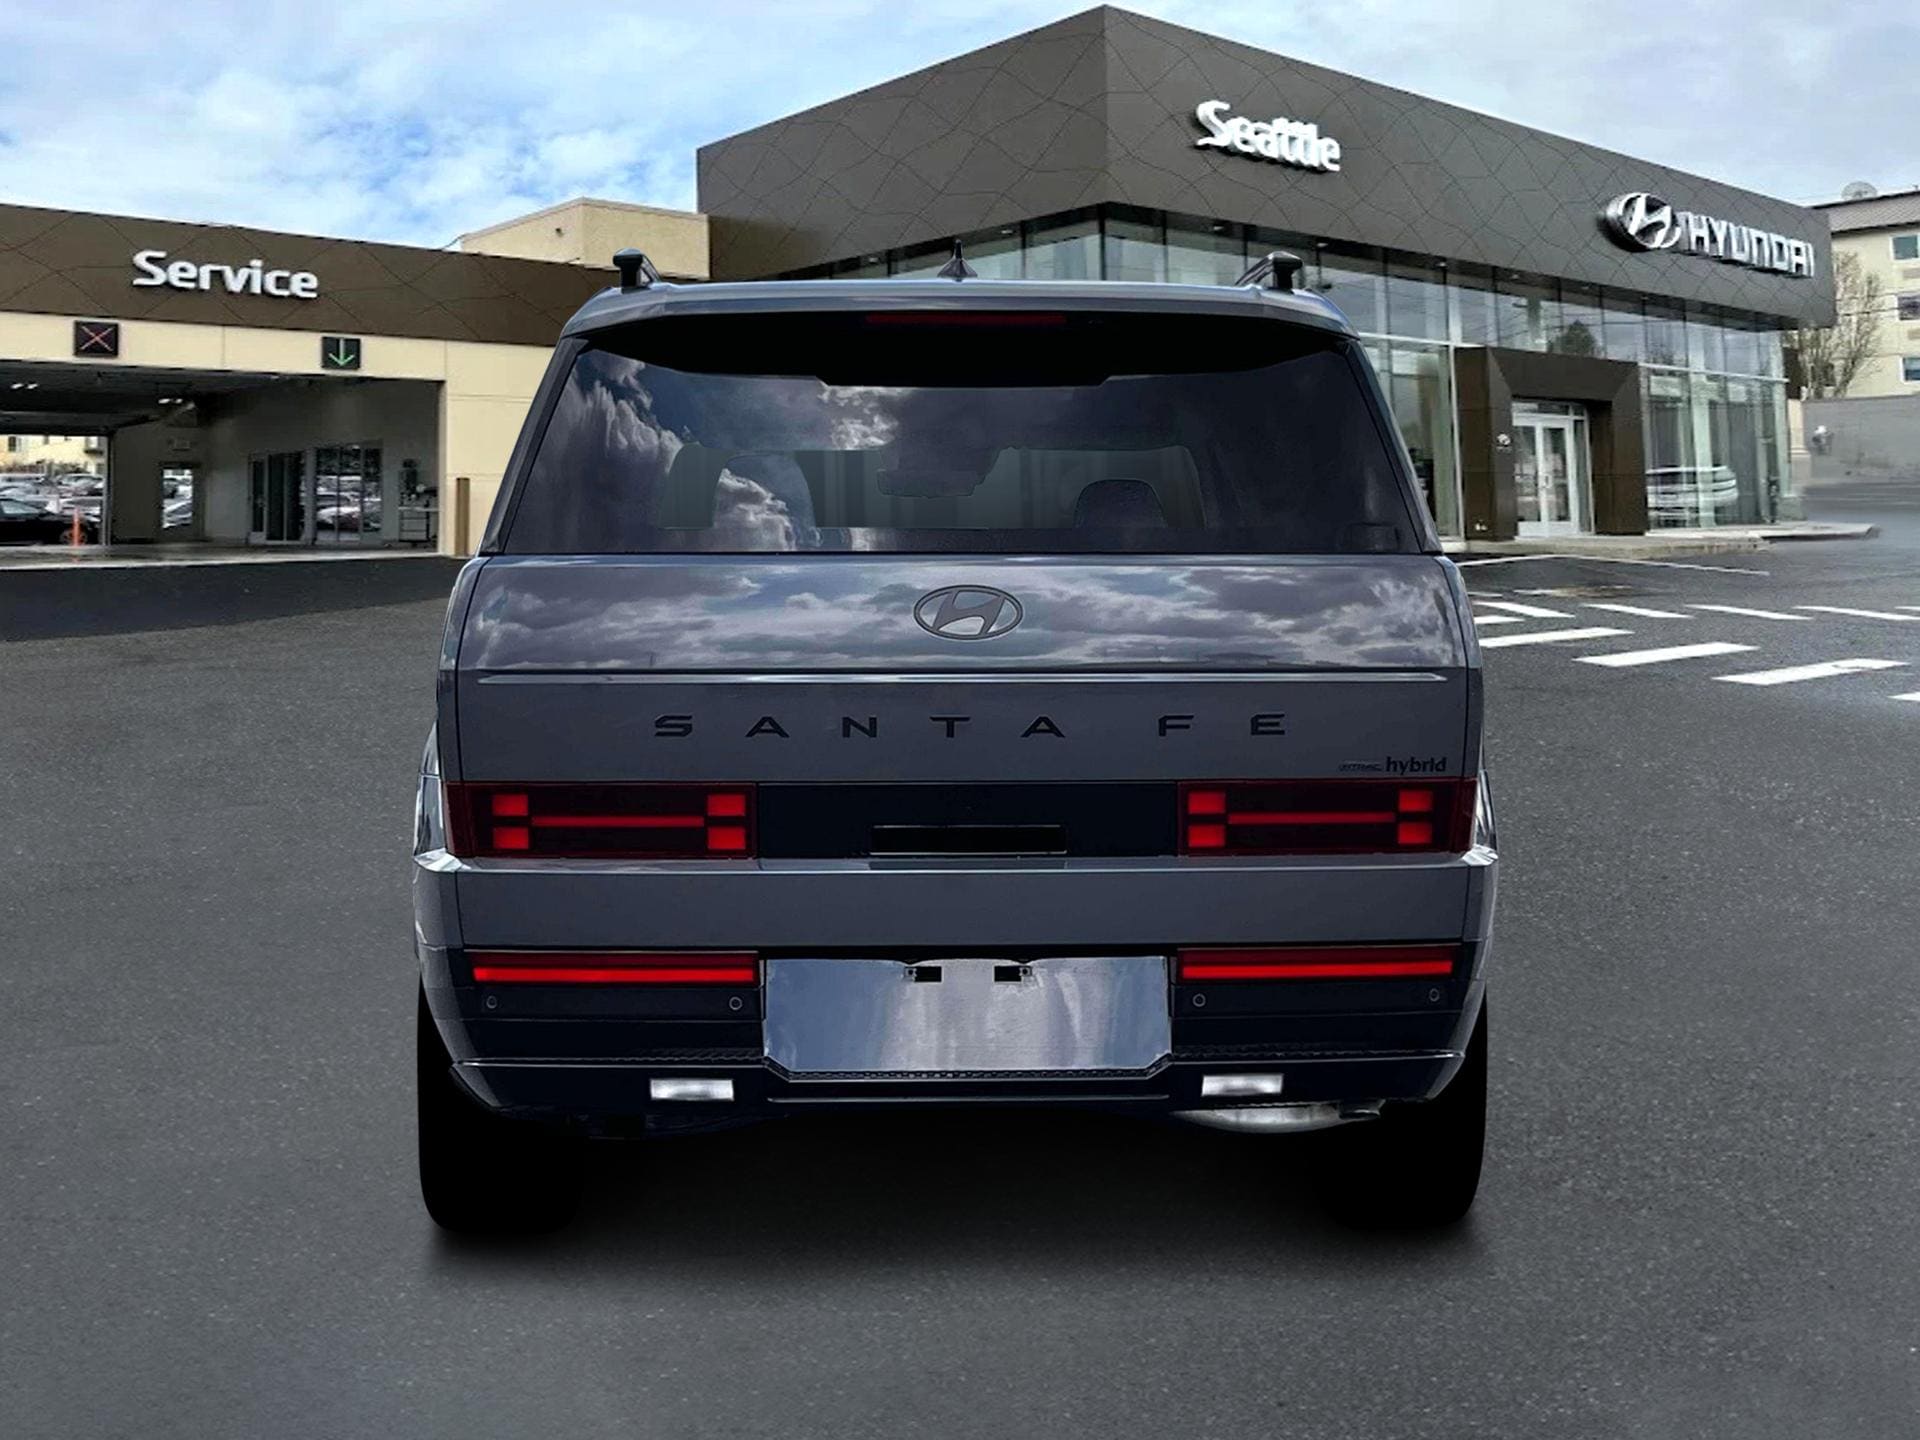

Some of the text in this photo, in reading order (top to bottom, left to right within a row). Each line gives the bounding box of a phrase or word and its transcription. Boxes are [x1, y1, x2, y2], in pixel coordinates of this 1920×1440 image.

[1196, 99, 1341, 172] Seattle
[1679, 211, 1815, 278] HYUNDAI
[132, 249, 319, 299] Service
[653, 713, 1286, 739] SANTA FE
[1385, 756, 1448, 776] hybrid
